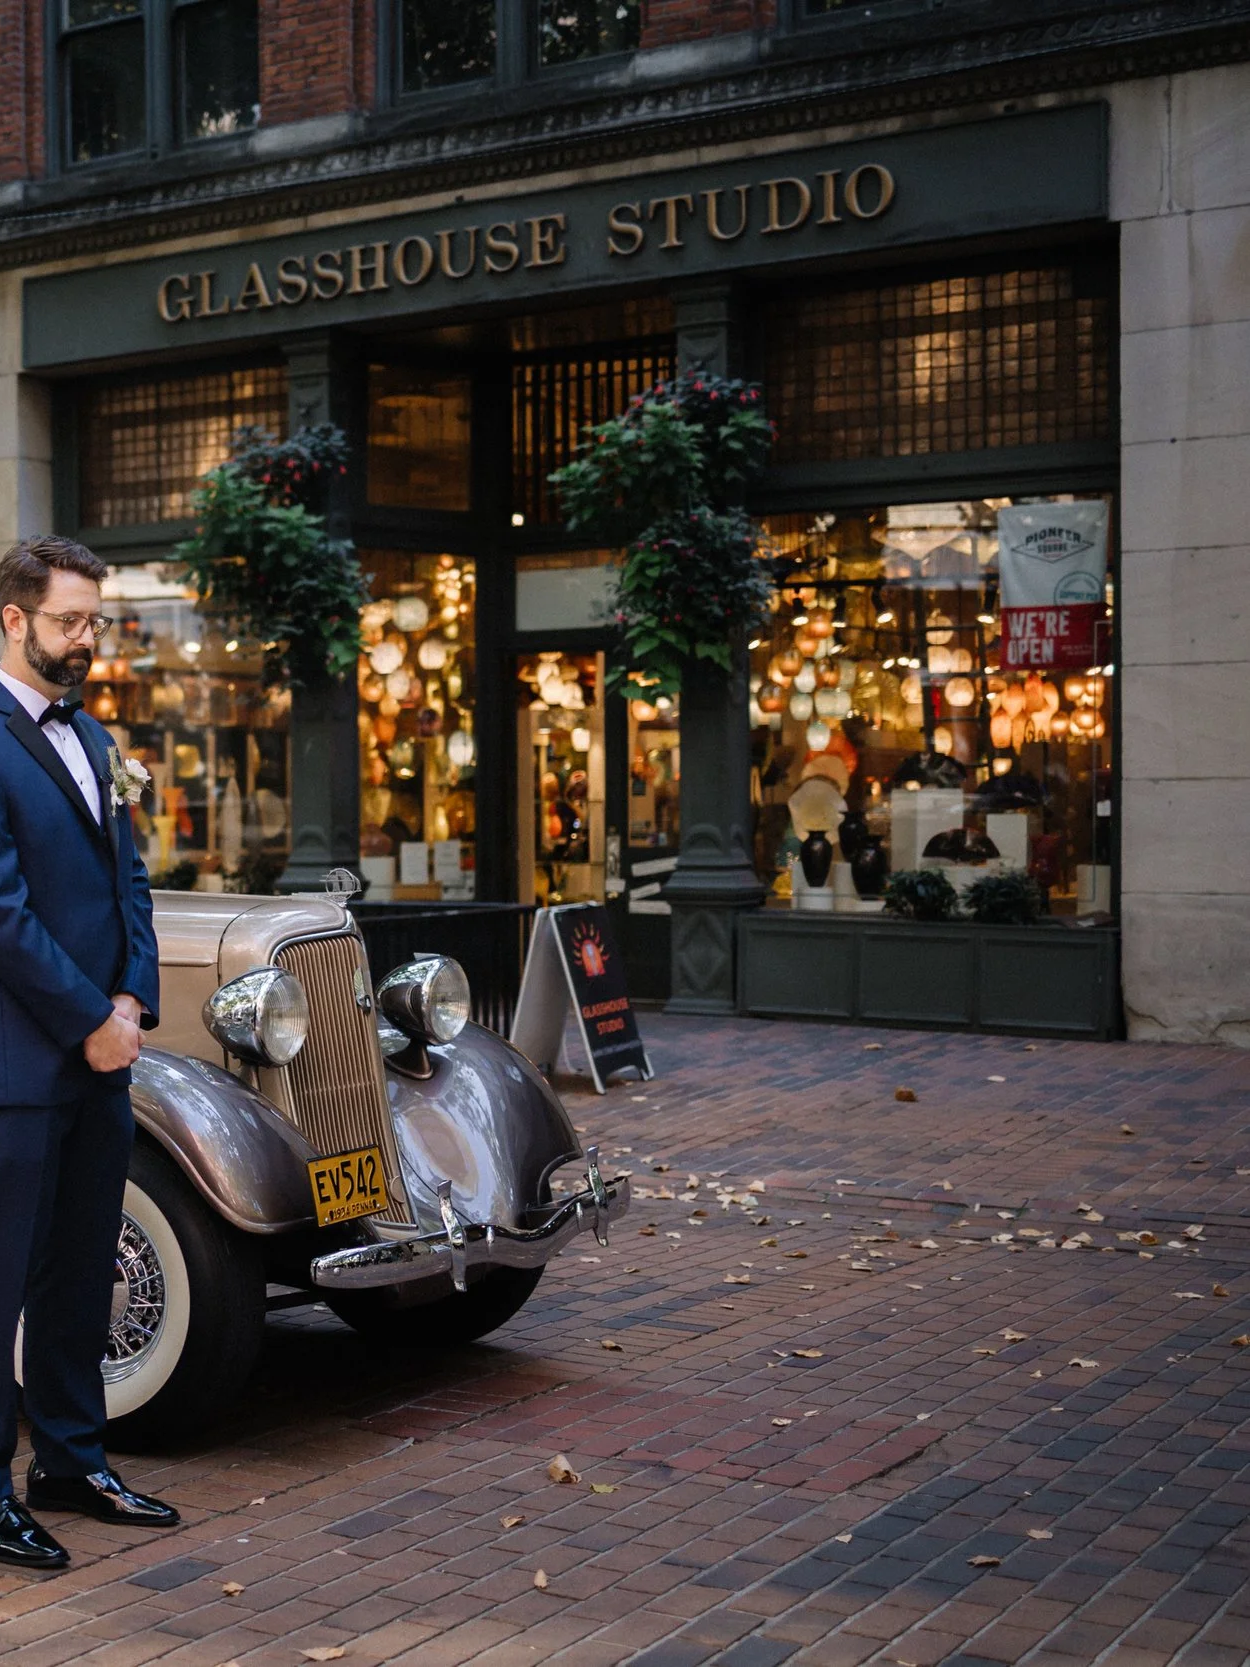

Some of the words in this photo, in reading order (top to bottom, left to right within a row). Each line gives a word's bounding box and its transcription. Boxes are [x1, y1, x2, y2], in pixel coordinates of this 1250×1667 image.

[156, 211, 565, 322] GLASSHOUSE
[608, 163, 896, 257] STUDIO
[1025, 526, 1082, 546] PIONEER
[1008, 611, 1071, 638] WE'RE
[1007, 638, 1055, 665] OPEN
[314, 1154, 380, 1204] EV542
